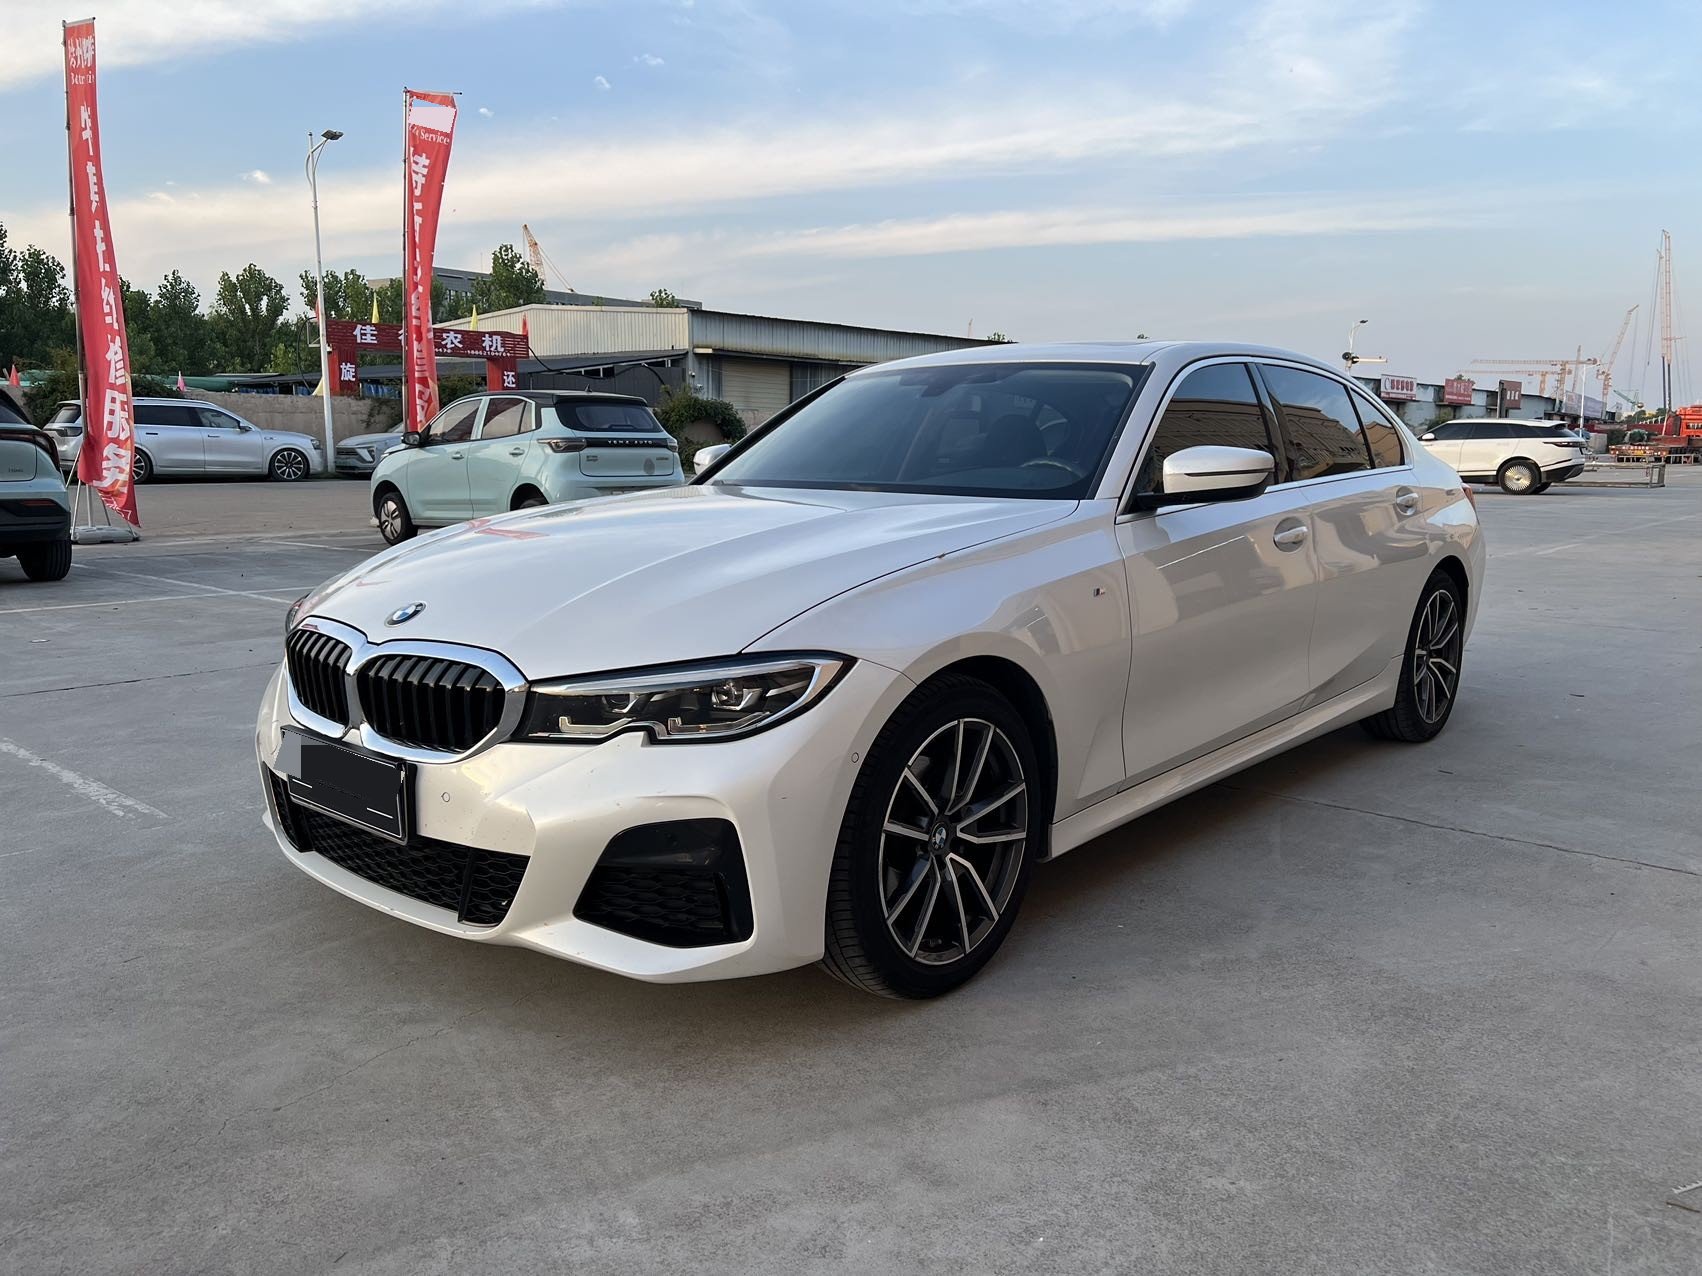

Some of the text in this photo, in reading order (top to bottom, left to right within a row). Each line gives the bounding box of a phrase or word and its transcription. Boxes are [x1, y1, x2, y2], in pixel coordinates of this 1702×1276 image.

[420, 128, 450, 146] Service
[340, 362, 356, 381] 旋
[503, 370, 516, 388] 还
